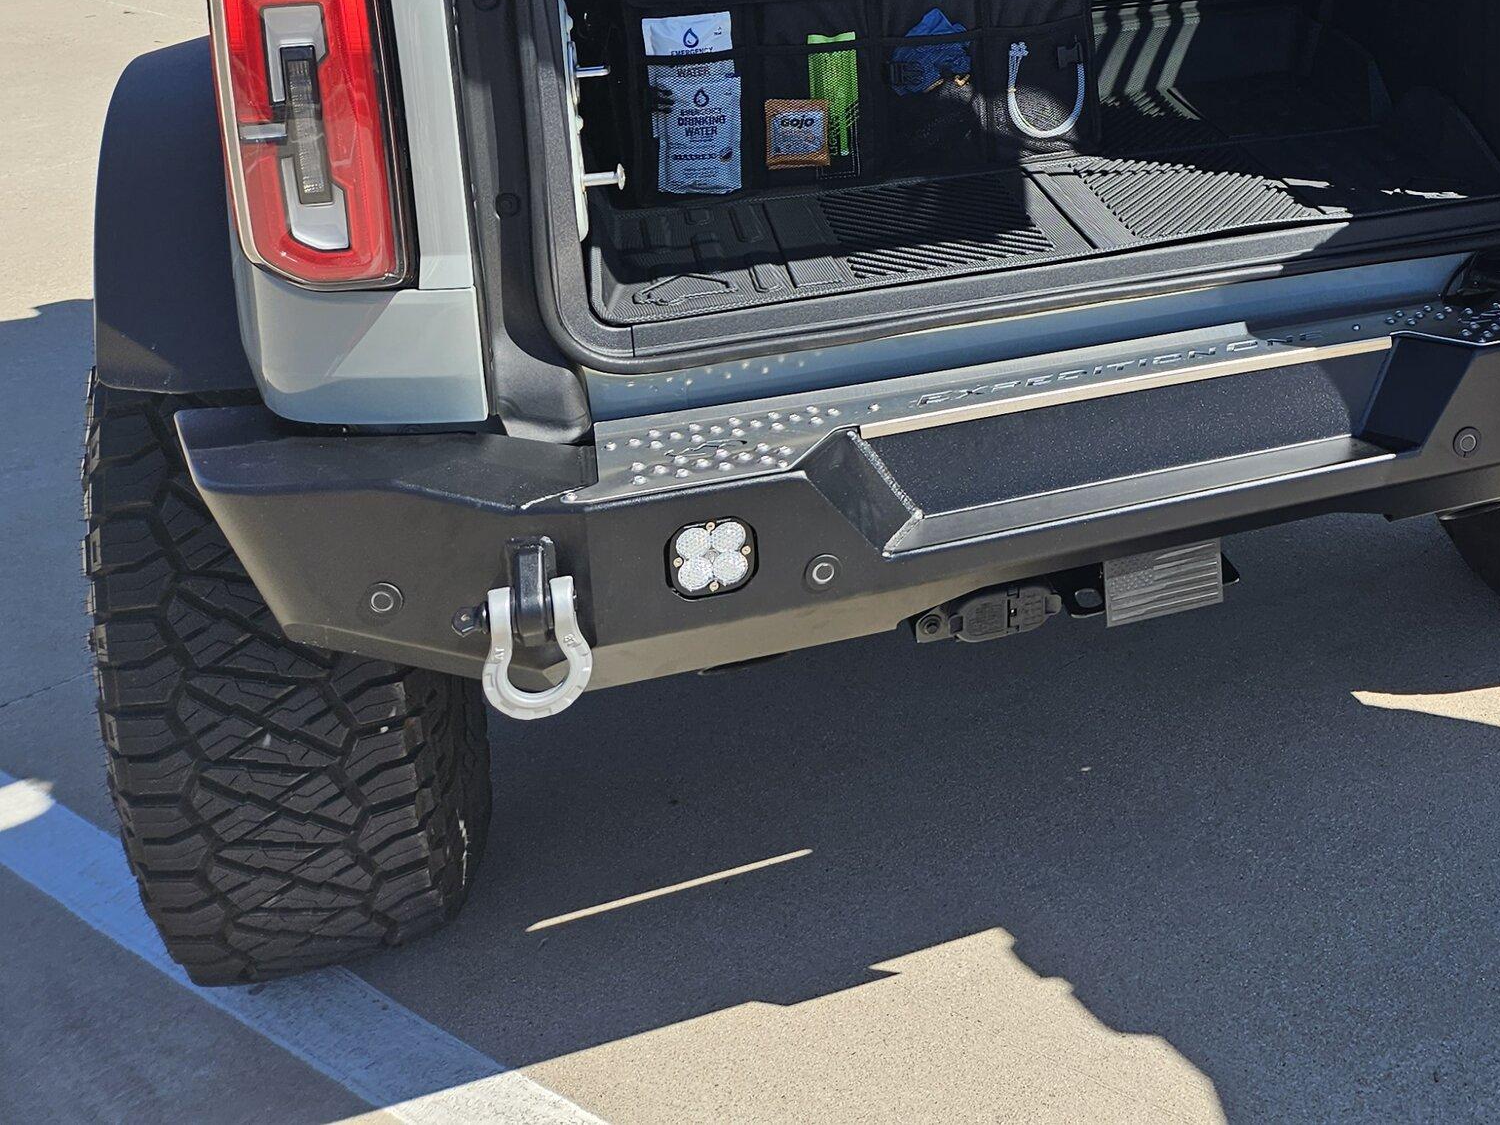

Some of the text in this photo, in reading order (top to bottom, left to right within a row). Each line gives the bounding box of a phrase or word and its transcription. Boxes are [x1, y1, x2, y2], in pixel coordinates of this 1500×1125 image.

[677, 115, 727, 127] DRINKING
[684, 126, 718, 137] WATER
[913, 329, 1324, 407] EXPEDITION ONE
